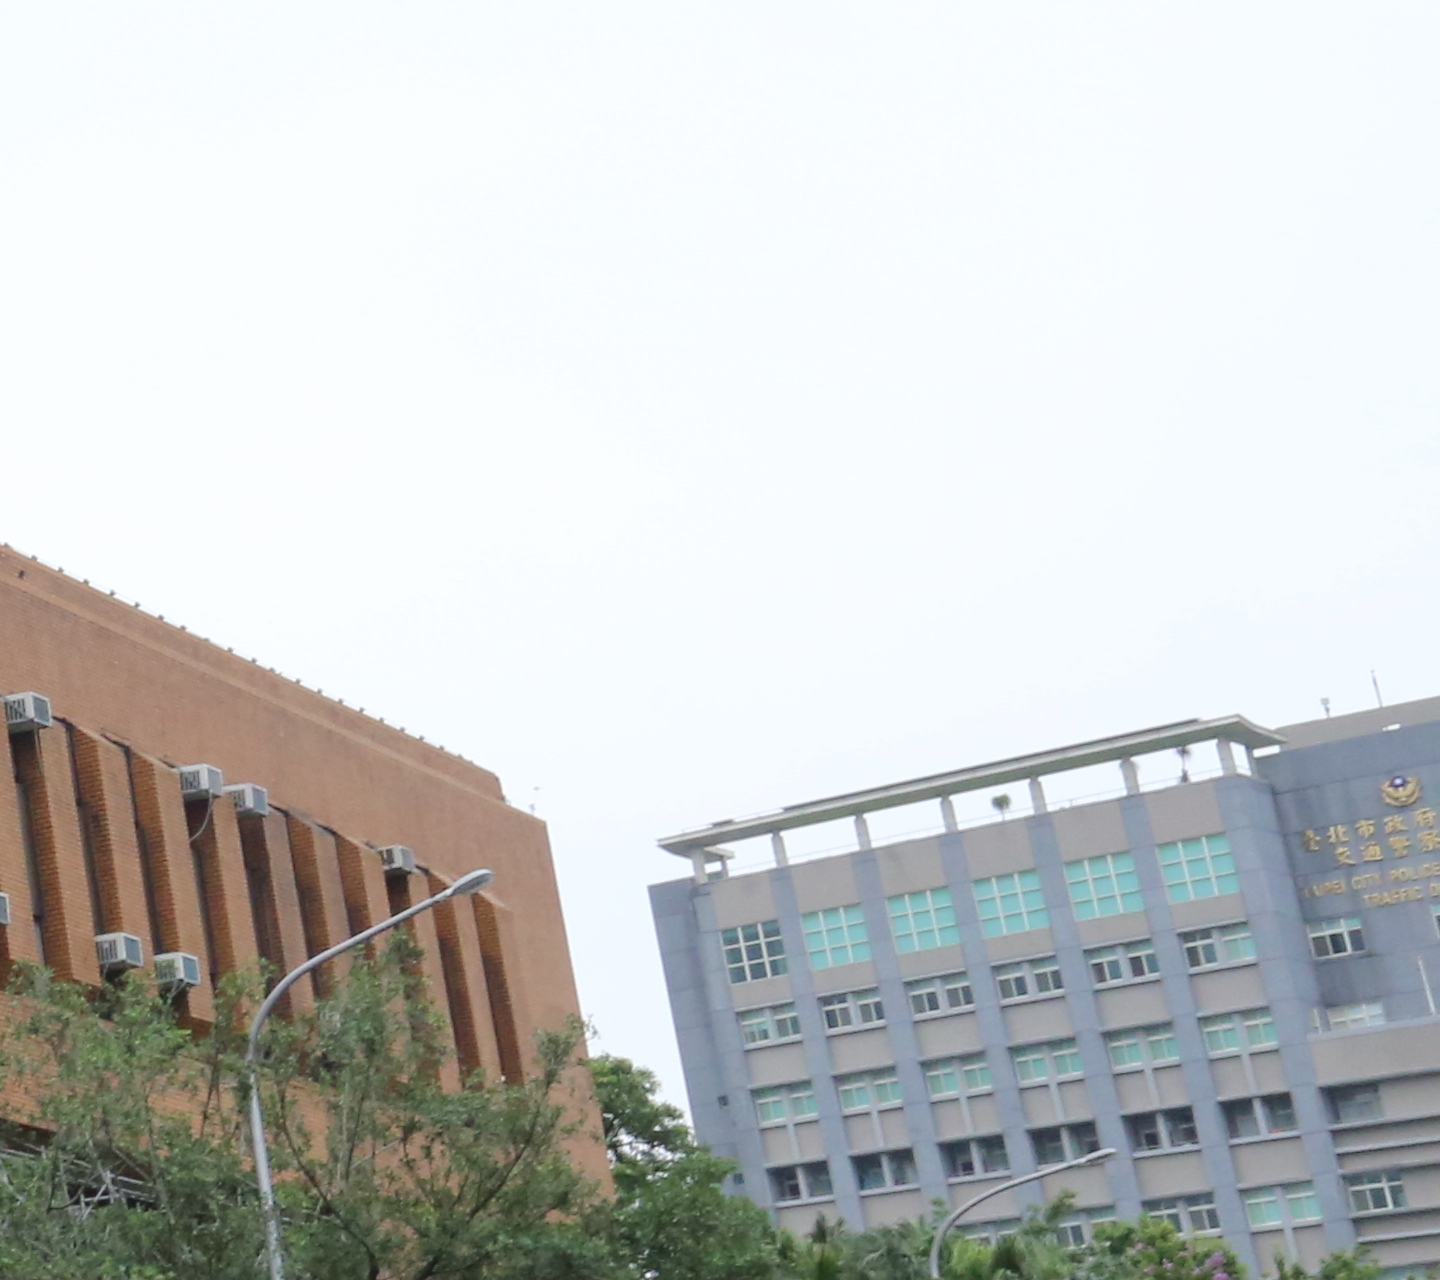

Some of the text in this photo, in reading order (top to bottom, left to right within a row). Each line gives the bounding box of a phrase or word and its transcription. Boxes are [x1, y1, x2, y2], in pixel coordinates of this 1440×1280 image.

[1303, 807, 1437, 852] 臺北市政府
